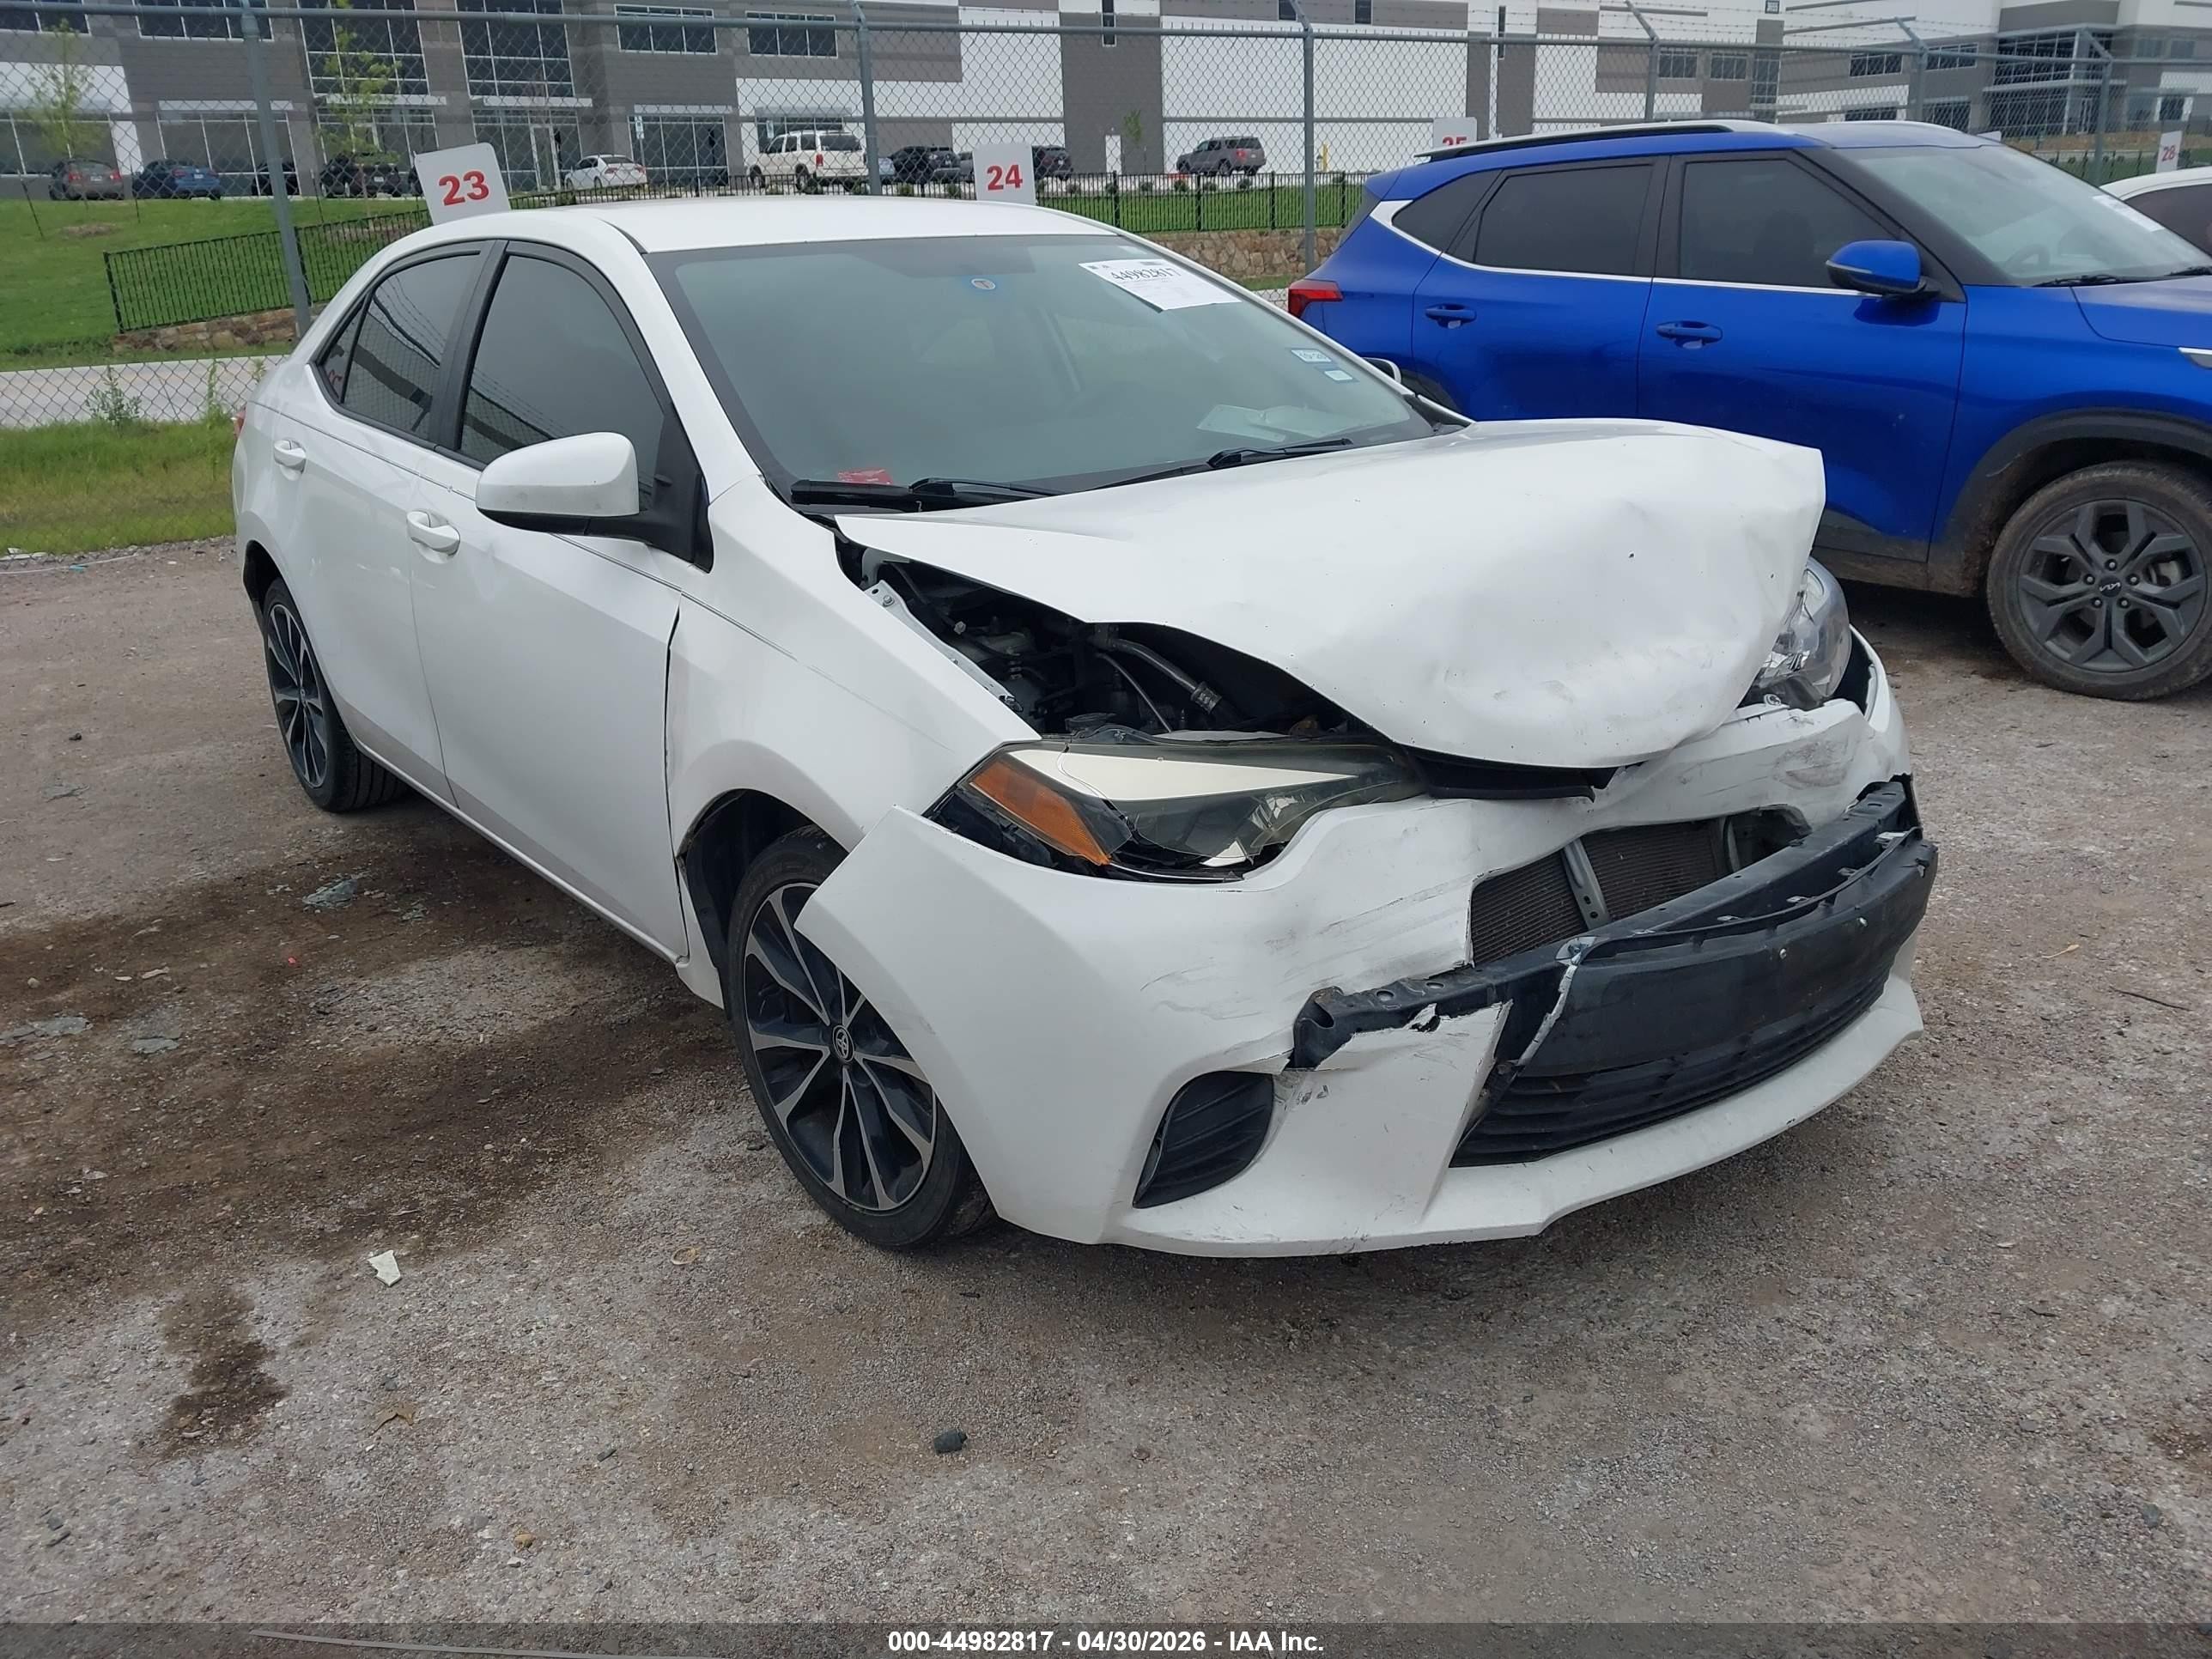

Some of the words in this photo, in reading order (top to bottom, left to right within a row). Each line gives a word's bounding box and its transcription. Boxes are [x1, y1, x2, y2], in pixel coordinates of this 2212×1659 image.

[2161, 145, 2176, 161] 28
[438, 170, 489, 206] 23
[987, 164, 1024, 191] 24
